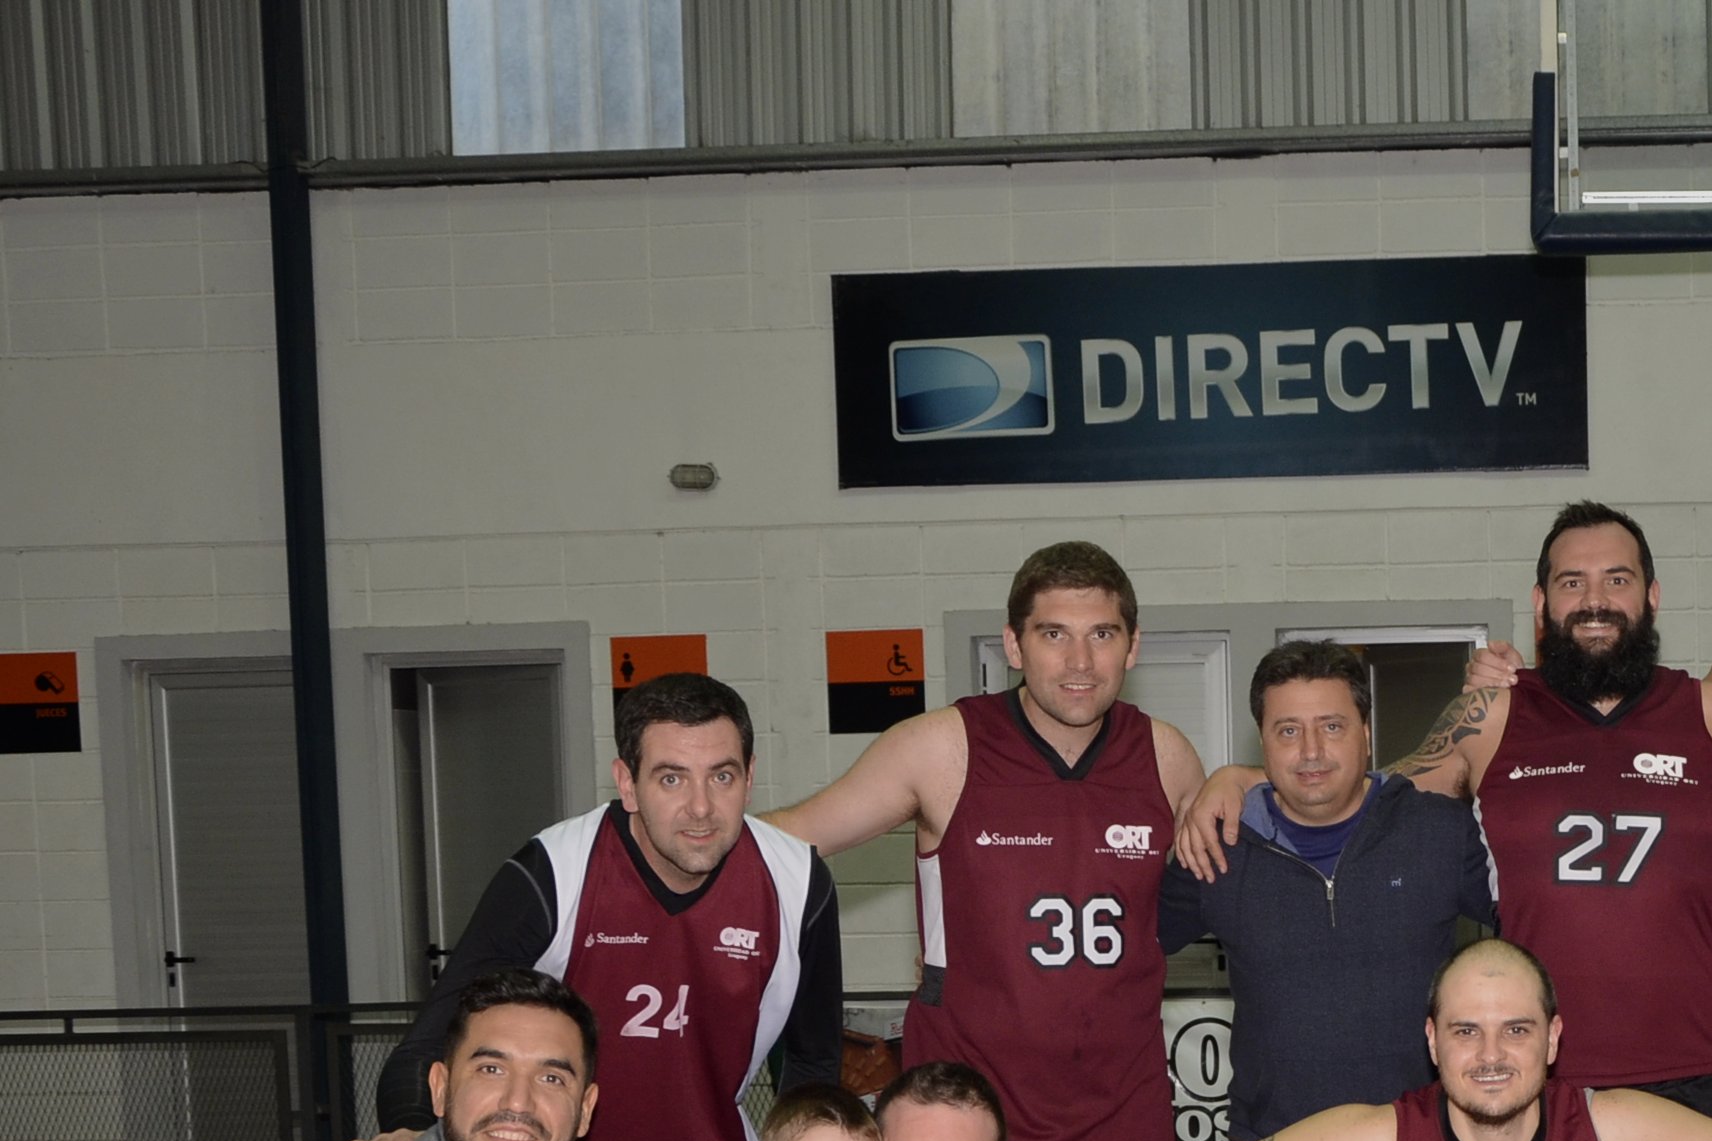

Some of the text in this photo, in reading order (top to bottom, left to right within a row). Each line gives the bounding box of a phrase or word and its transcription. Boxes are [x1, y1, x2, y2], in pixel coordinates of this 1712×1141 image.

[1081, 320, 1537, 425] DIRECTV TM
[1523, 761, 1586, 778] Santander
[1633, 752, 1687, 778] ORT
[991, 832, 1054, 846] Santander
[1104, 823, 1152, 851] ORT
[1557, 813, 1664, 884] 27
[596, 931, 650, 945] Santander
[719, 926, 760, 950] ORT
[1027, 894, 1125, 968] 36
[619, 983, 690, 1039] 24
